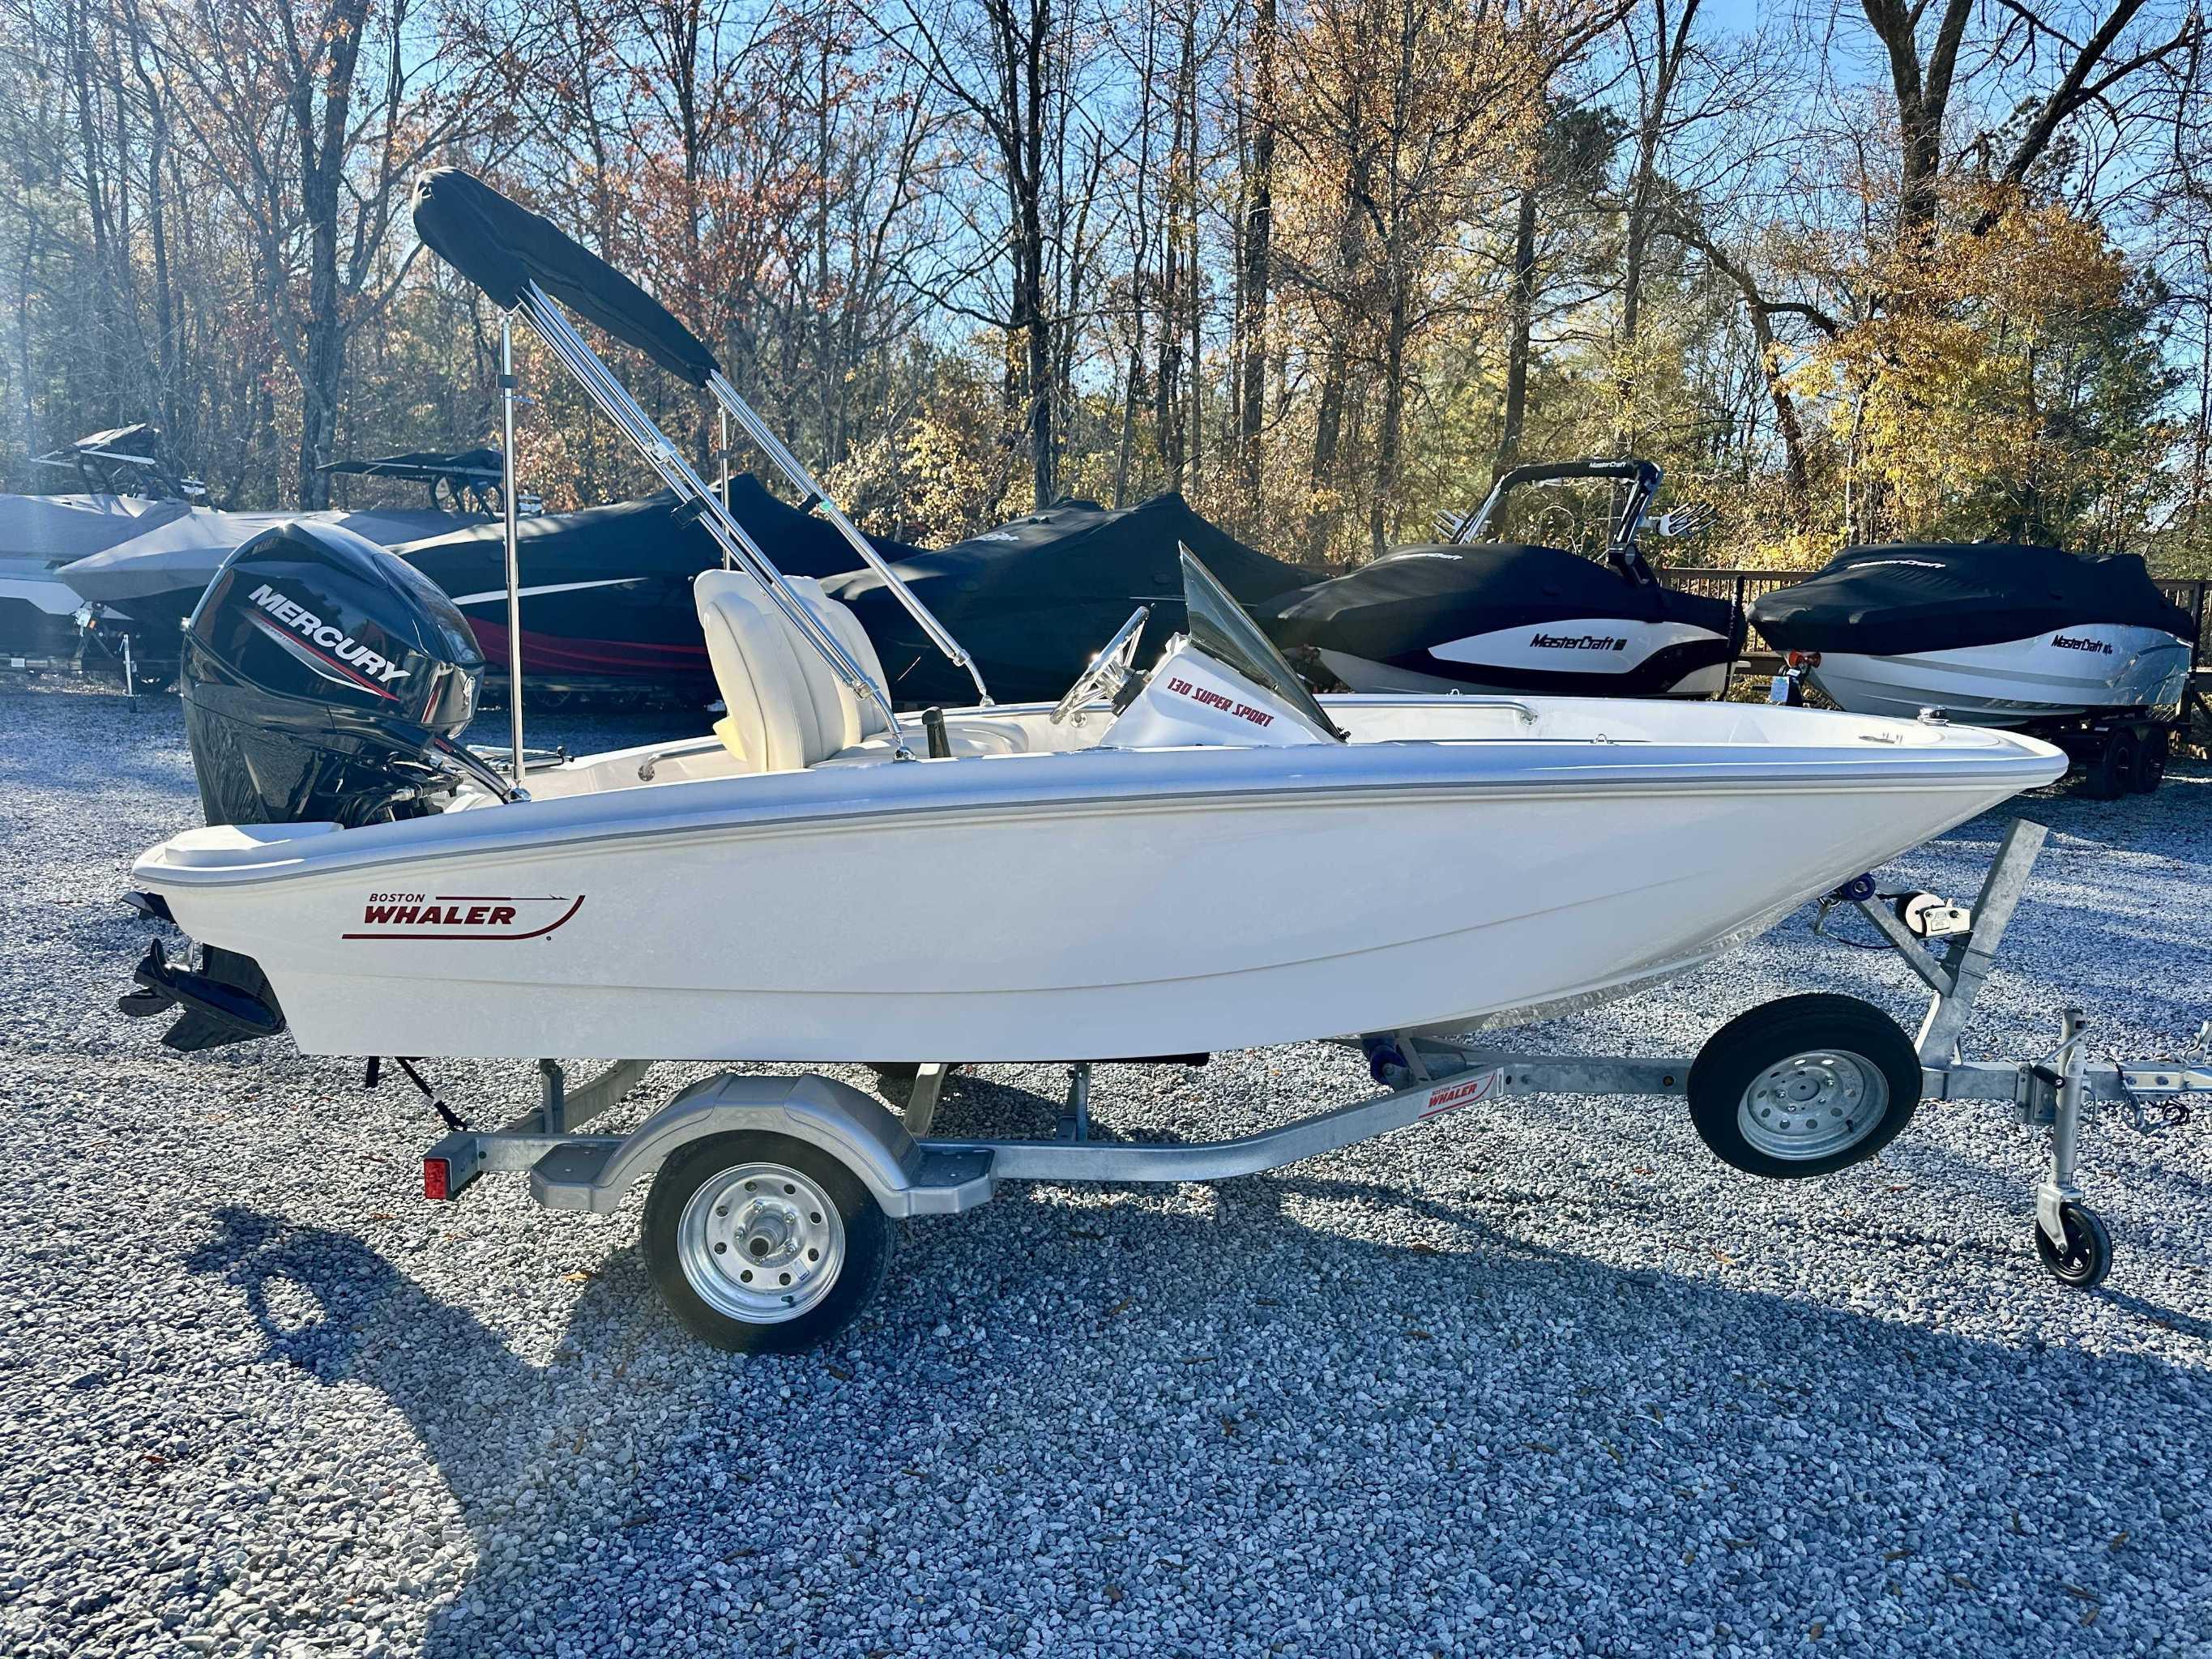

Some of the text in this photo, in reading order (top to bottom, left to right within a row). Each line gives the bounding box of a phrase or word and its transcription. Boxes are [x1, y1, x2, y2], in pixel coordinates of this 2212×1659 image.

[248, 583, 412, 683] MERCURY
[1529, 633, 1614, 650] MasterCraft
[2051, 634, 2103, 653] MasterCraft
[1167, 677, 1275, 727] 130 SUPER SPORT
[369, 893, 425, 903] BOSTON
[364, 906, 516, 925] WHALER
[1428, 1082, 1478, 1108] WHALER
